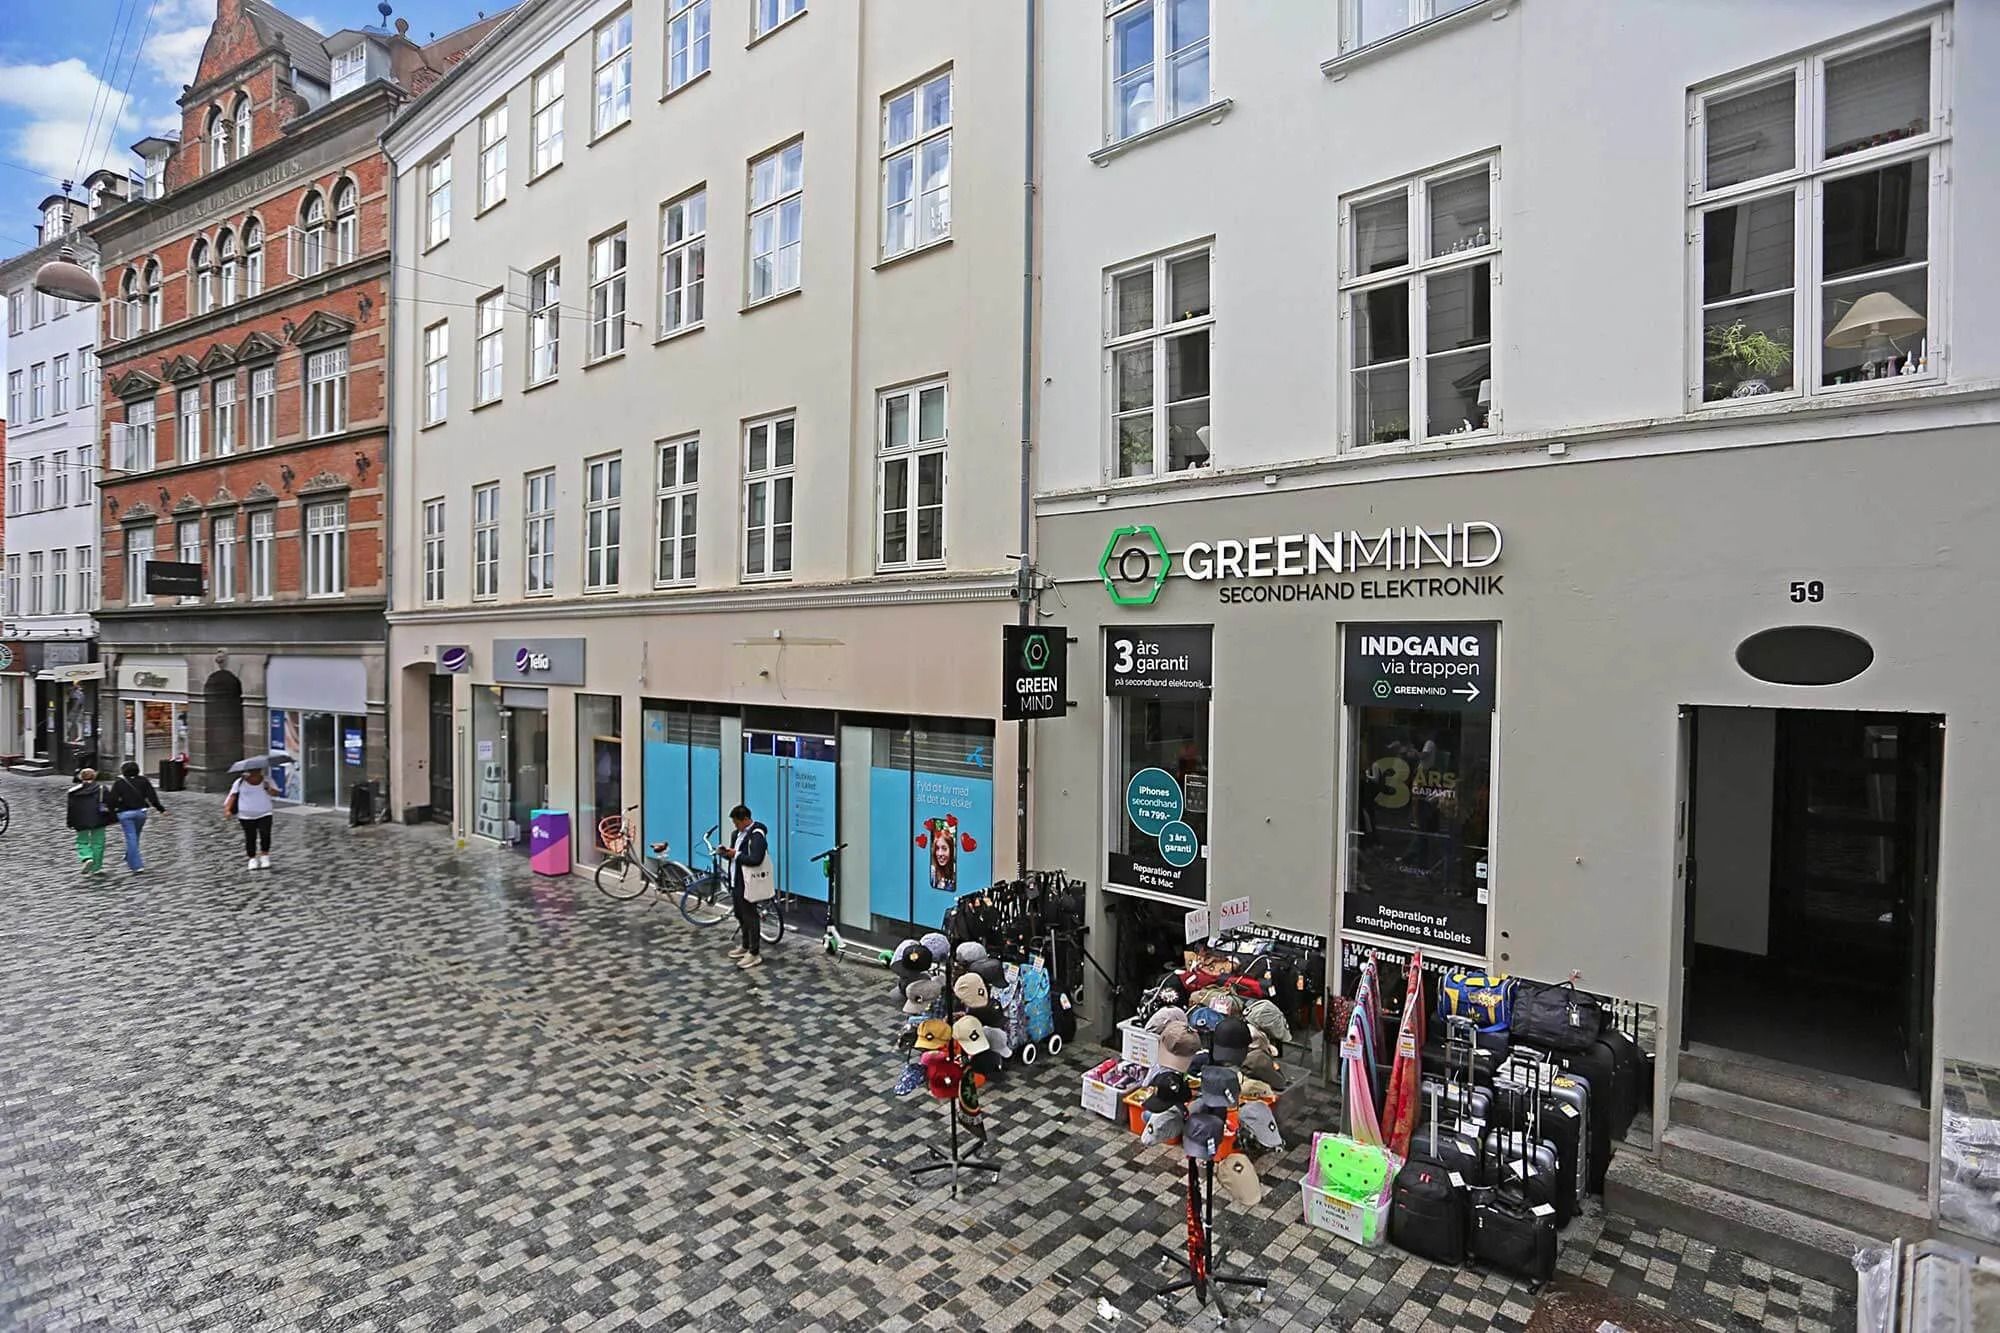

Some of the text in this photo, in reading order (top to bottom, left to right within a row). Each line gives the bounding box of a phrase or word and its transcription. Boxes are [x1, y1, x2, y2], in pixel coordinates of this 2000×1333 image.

[1182, 520, 1503, 581] GREENMIND
[1219, 575, 1504, 604] SECONDHAND ELEKTRONIK
[1790, 580, 1824, 604] 59
[1360, 636, 1480, 657] INDGANG
[528, 652, 550, 670] Telia
[1113, 639, 1160, 674] 3 års
[1136, 655, 1189, 674] garanti
[1381, 658, 1480, 679] via trappen
[1016, 676, 1058, 694] GREEN
[1114, 677, 1204, 689] på secondhand elektronik
[1394, 685, 1447, 696] GREENMIND
[1020, 695, 1054, 713] MIND
[1139, 785, 1170, 797] iPhones
[1374, 756, 1411, 808] 3
[1132, 797, 1178, 809] secondhand
[1138, 808, 1150, 818] fra
[1169, 833, 1187, 842] 3 års
[1164, 843, 1192, 854] garanti
[1133, 862, 1182, 879] Reparation af
[1139, 874, 1174, 888] PC & Mac
[1222, 900, 1249, 918] SALE
[1378, 905, 1448, 927] Reparation af
[1236, 924, 1320, 949] oman Paradis
[1355, 915, 1472, 944] smartphones & tablets
